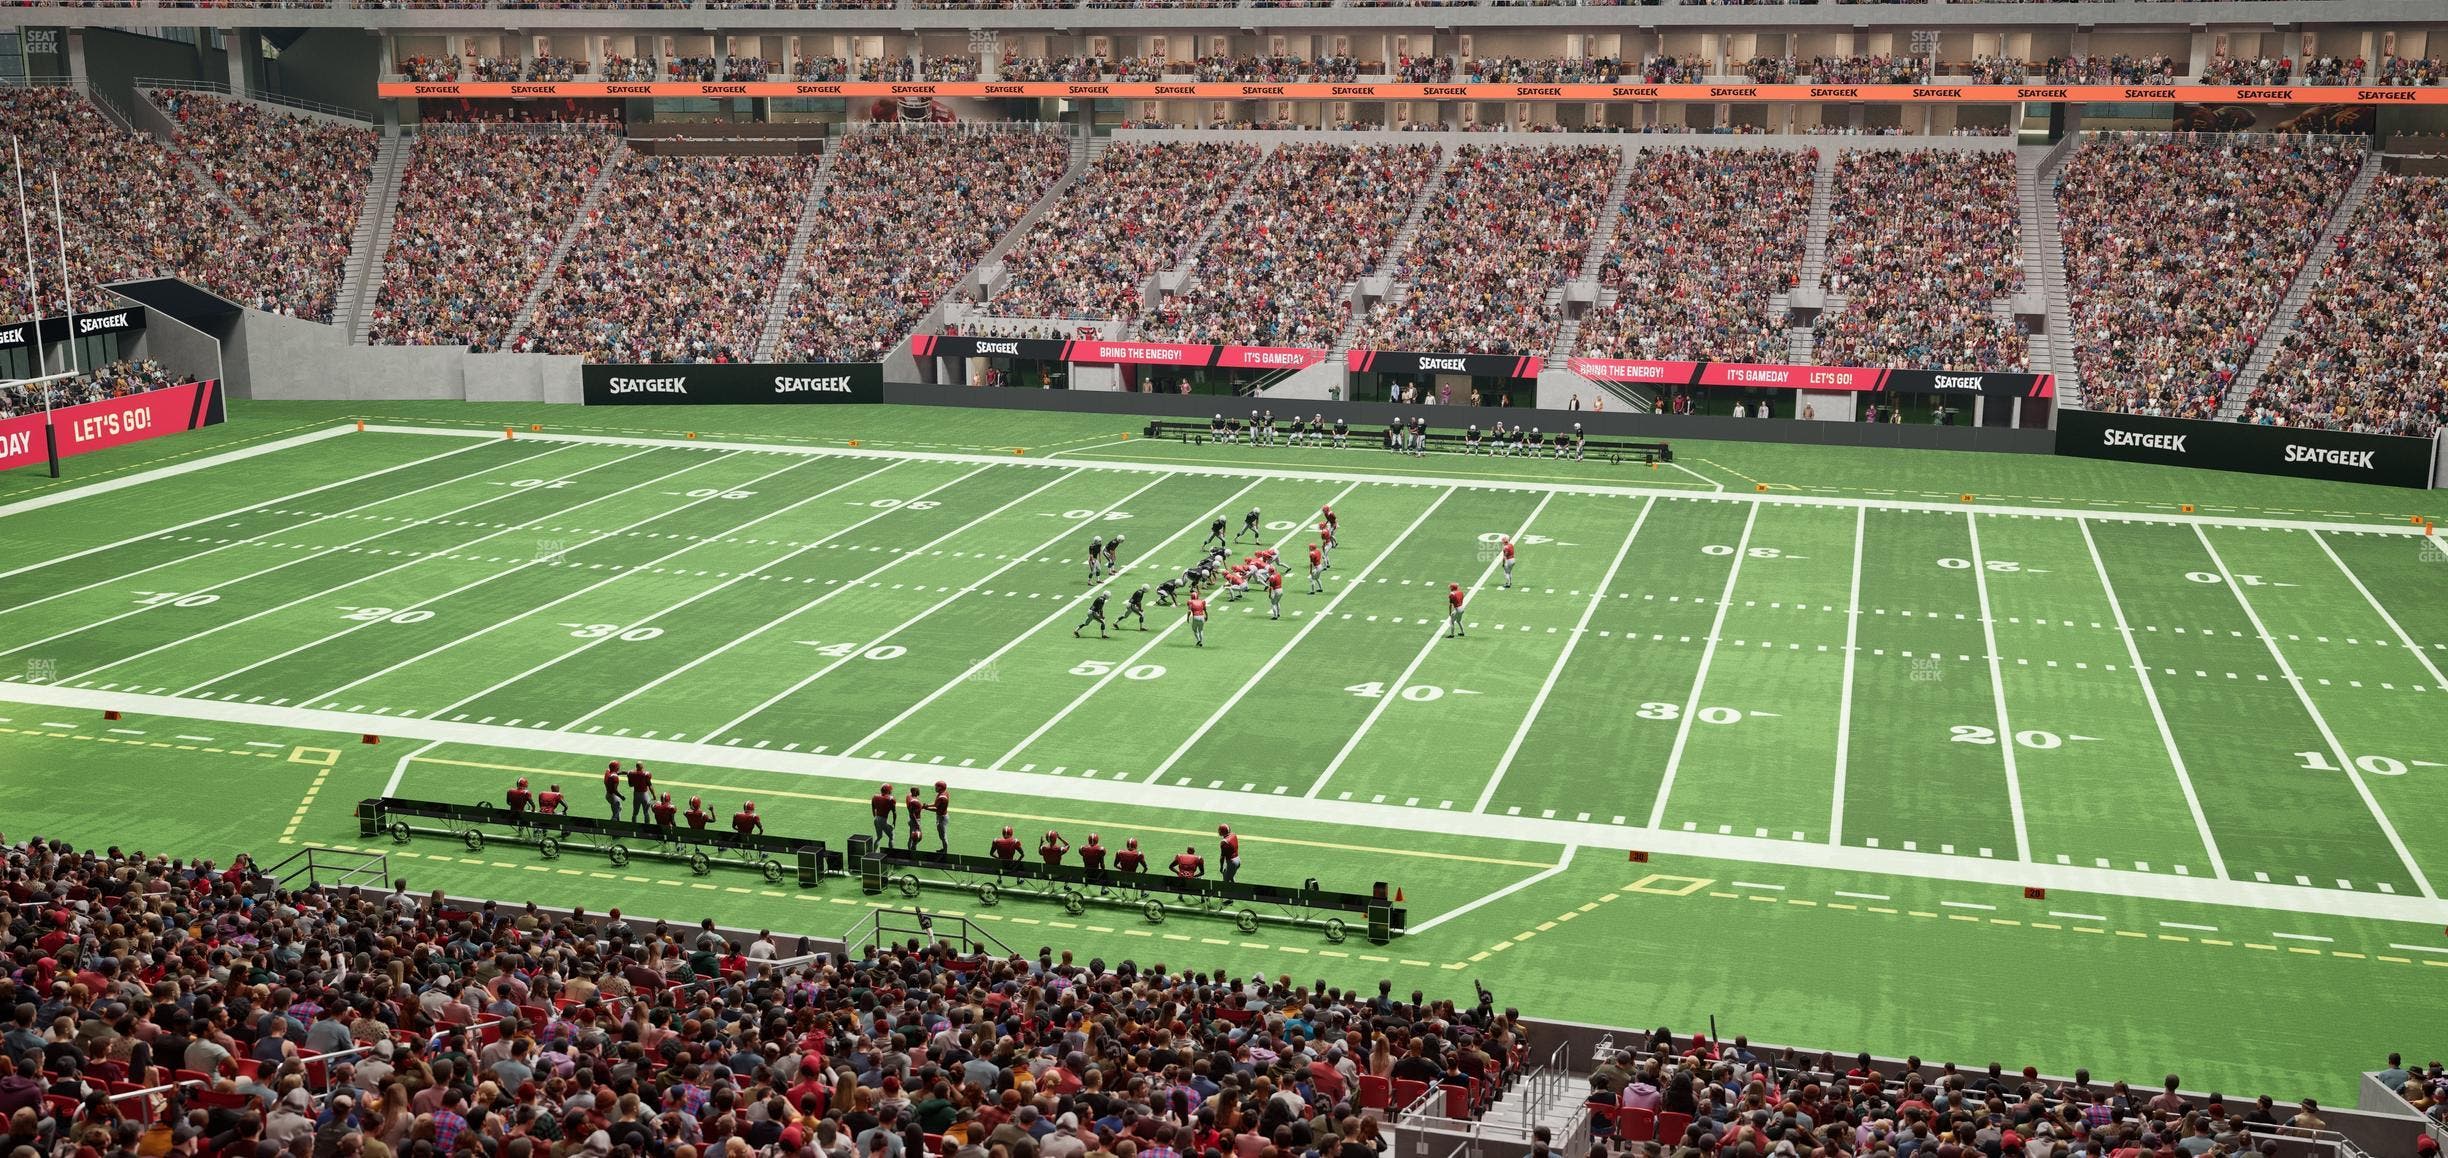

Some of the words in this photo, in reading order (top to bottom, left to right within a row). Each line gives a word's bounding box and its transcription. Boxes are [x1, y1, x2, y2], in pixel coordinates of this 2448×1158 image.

[414, 85, 460, 93] SEATGEEK
[510, 85, 556, 93] SEATGEEK
[606, 85, 651, 93] SEATGEEK
[701, 85, 746, 93] SEATGEEK
[796, 85, 841, 93] SEATGEEK
[891, 85, 936, 93] SEATGEEK
[984, 85, 1025, 93] SEATGEEK
[1068, 85, 1109, 94] SEATGEEK
[1154, 85, 1196, 94] SEATGEEK
[1242, 86, 1284, 95] SEATGEEK
[1331, 86, 1375, 95] SEATGEEK
[1423, 86, 1467, 96] SEATGEEK
[1516, 87, 1562, 96] SEATGEEK
[1612, 87, 1658, 96] SEATGEEK
[1710, 87, 1757, 97] SEATGEEK
[1810, 88, 1858, 97] SEATGEEK
[1912, 88, 1962, 98] SEATGEEK
[2017, 88, 2068, 98] SEATGEEK
[2124, 89, 2176, 99] SEATGEEK
[2236, 89, 2293, 100] SEATGEEK
[2357, 90, 2417, 101] SEATGEEK
[80, 312, 129, 333] SEATGEEK
[976, 341, 1019, 355] SEATGEEK
[1100, 347, 1126, 358] BRING
[1128, 348, 1144, 359] THE
[1146, 349, 1182, 360] ENERGY!
[1244, 352, 1261, 363] IT'S
[1263, 353, 1304, 364] GAMEDAY
[1419, 356, 1466, 372] SEATGEEK
[1609, 365, 1625, 377] THE
[1627, 366, 1664, 378] ENERGY!
[1727, 369, 1744, 381] IT'S
[1746, 370, 1789, 383] GAMEDAY
[774, 376, 852, 393] SEATGEEK
[1810, 372, 1835, 384] LET'S
[1837, 373, 1853, 385] GO!
[1934, 375, 1983, 391] SEATGEEK
[609, 377, 687, 394] SEATGEEK
[74, 416, 119, 442] LET'S
[123, 406, 151, 432] GO!
[2103, 428, 2187, 453] SEATGEEK
[2284, 444, 2375, 470] SEATGEEK
[1701, 545, 1782, 559] 30
[1936, 558, 2021, 573] 20
[131, 592, 221, 607] 10
[338, 607, 436, 624] 20
[570, 623, 665, 641] 30
[811, 642, 908, 660] 40
[1068, 660, 1167, 681] 50
[1343, 682, 1445, 702] 40
[1635, 702, 1743, 724] 30
[1949, 725, 2063, 749] 20
[2294, 751, 2409, 776] 10
